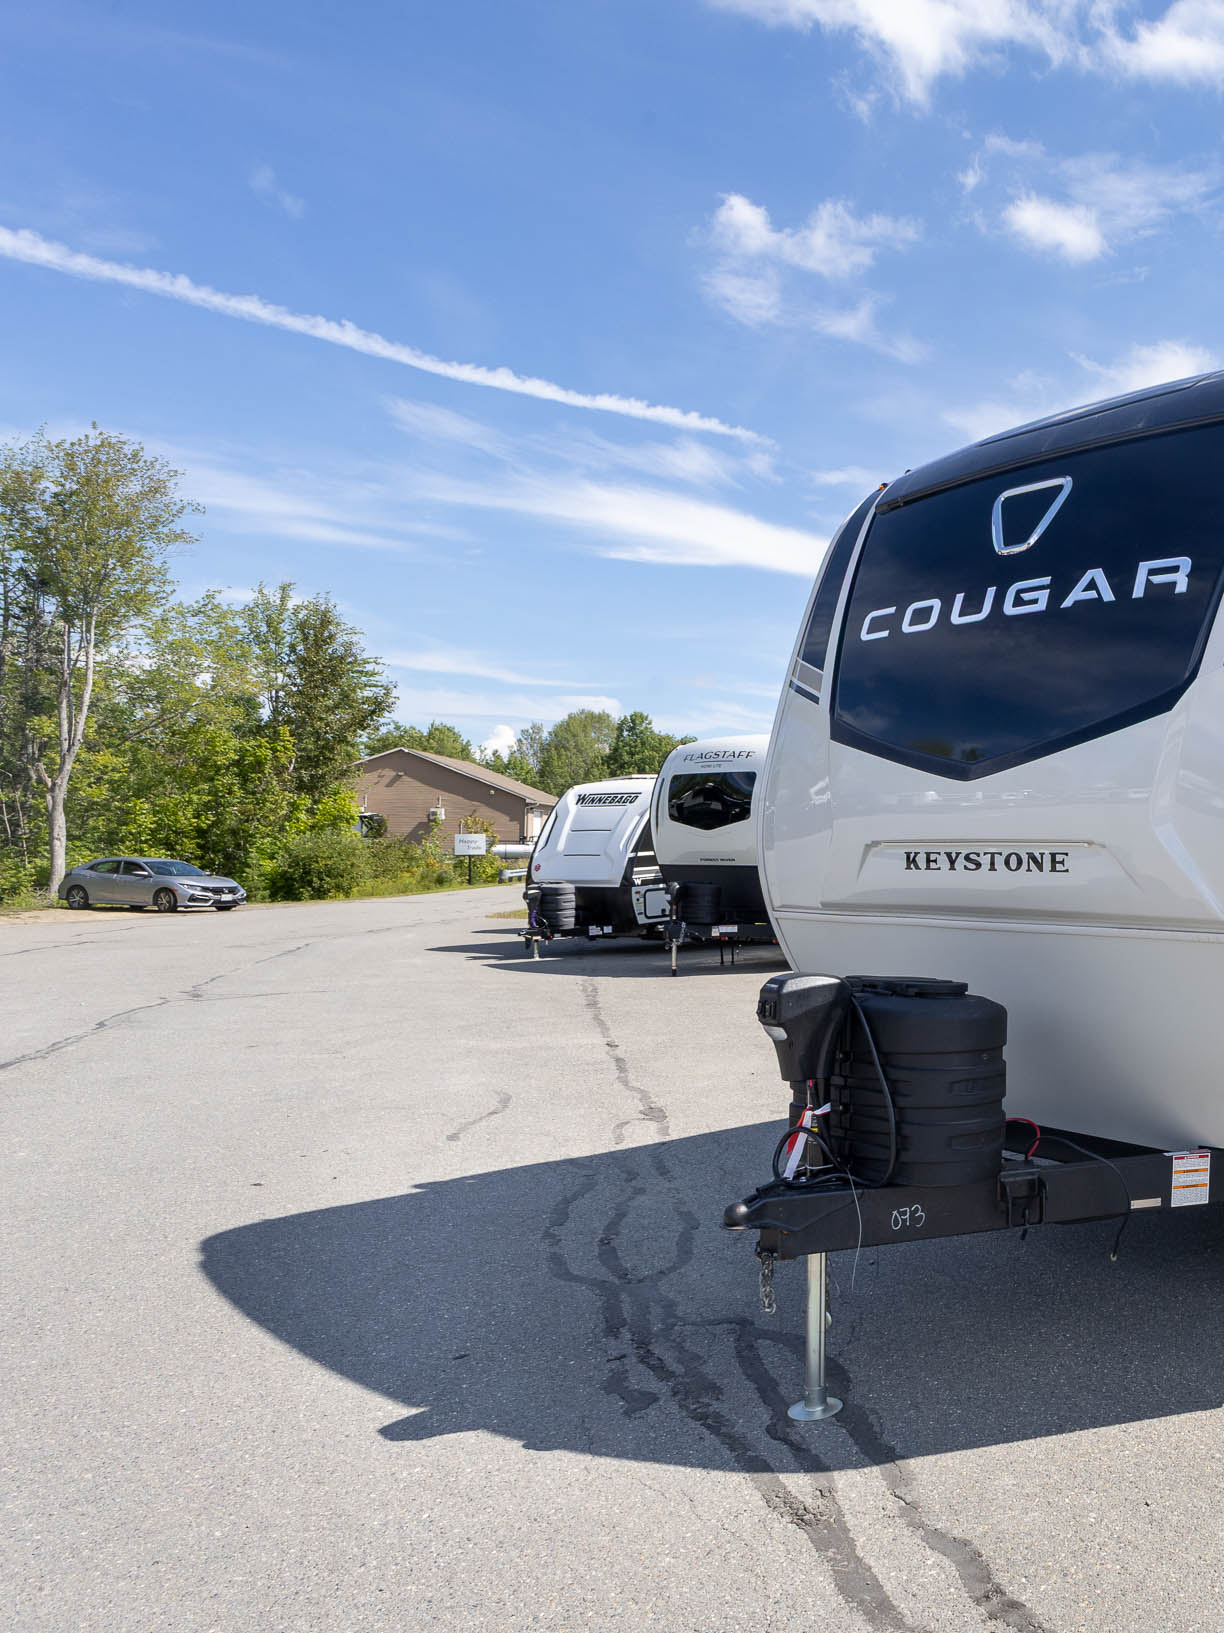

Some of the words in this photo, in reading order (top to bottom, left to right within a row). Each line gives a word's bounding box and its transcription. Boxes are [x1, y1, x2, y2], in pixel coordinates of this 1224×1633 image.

[860, 556, 1193, 641] COUGAR
[683, 750, 756, 762] FLAGSTAFF
[575, 794, 639, 806] WINNEBAGO
[903, 850, 1070, 874] KEYSTONE
[891, 1204, 926, 1230] 073
